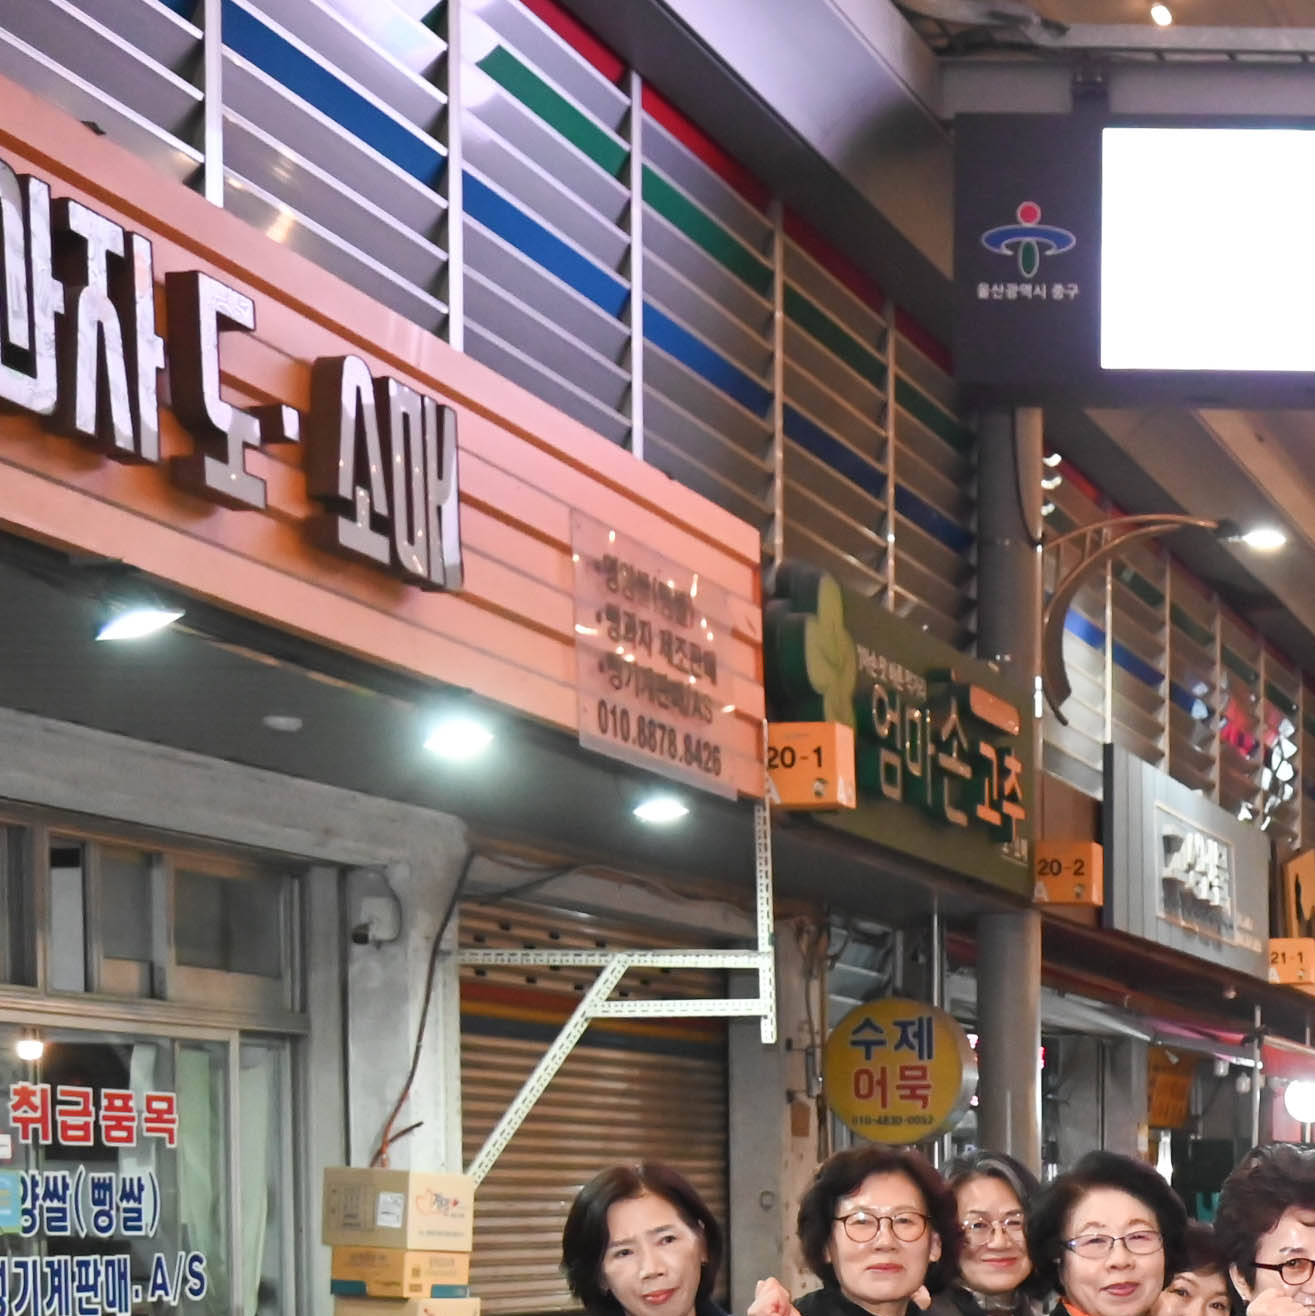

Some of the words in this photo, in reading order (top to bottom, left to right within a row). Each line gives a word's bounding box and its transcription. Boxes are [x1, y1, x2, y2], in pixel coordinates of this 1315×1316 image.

[1037, 859, 1085, 876] 20-2
[849, 1016, 934, 1061] 수제
[853, 1065, 932, 1110] 어묵
[9, 1081, 179, 1148] 취급품목
